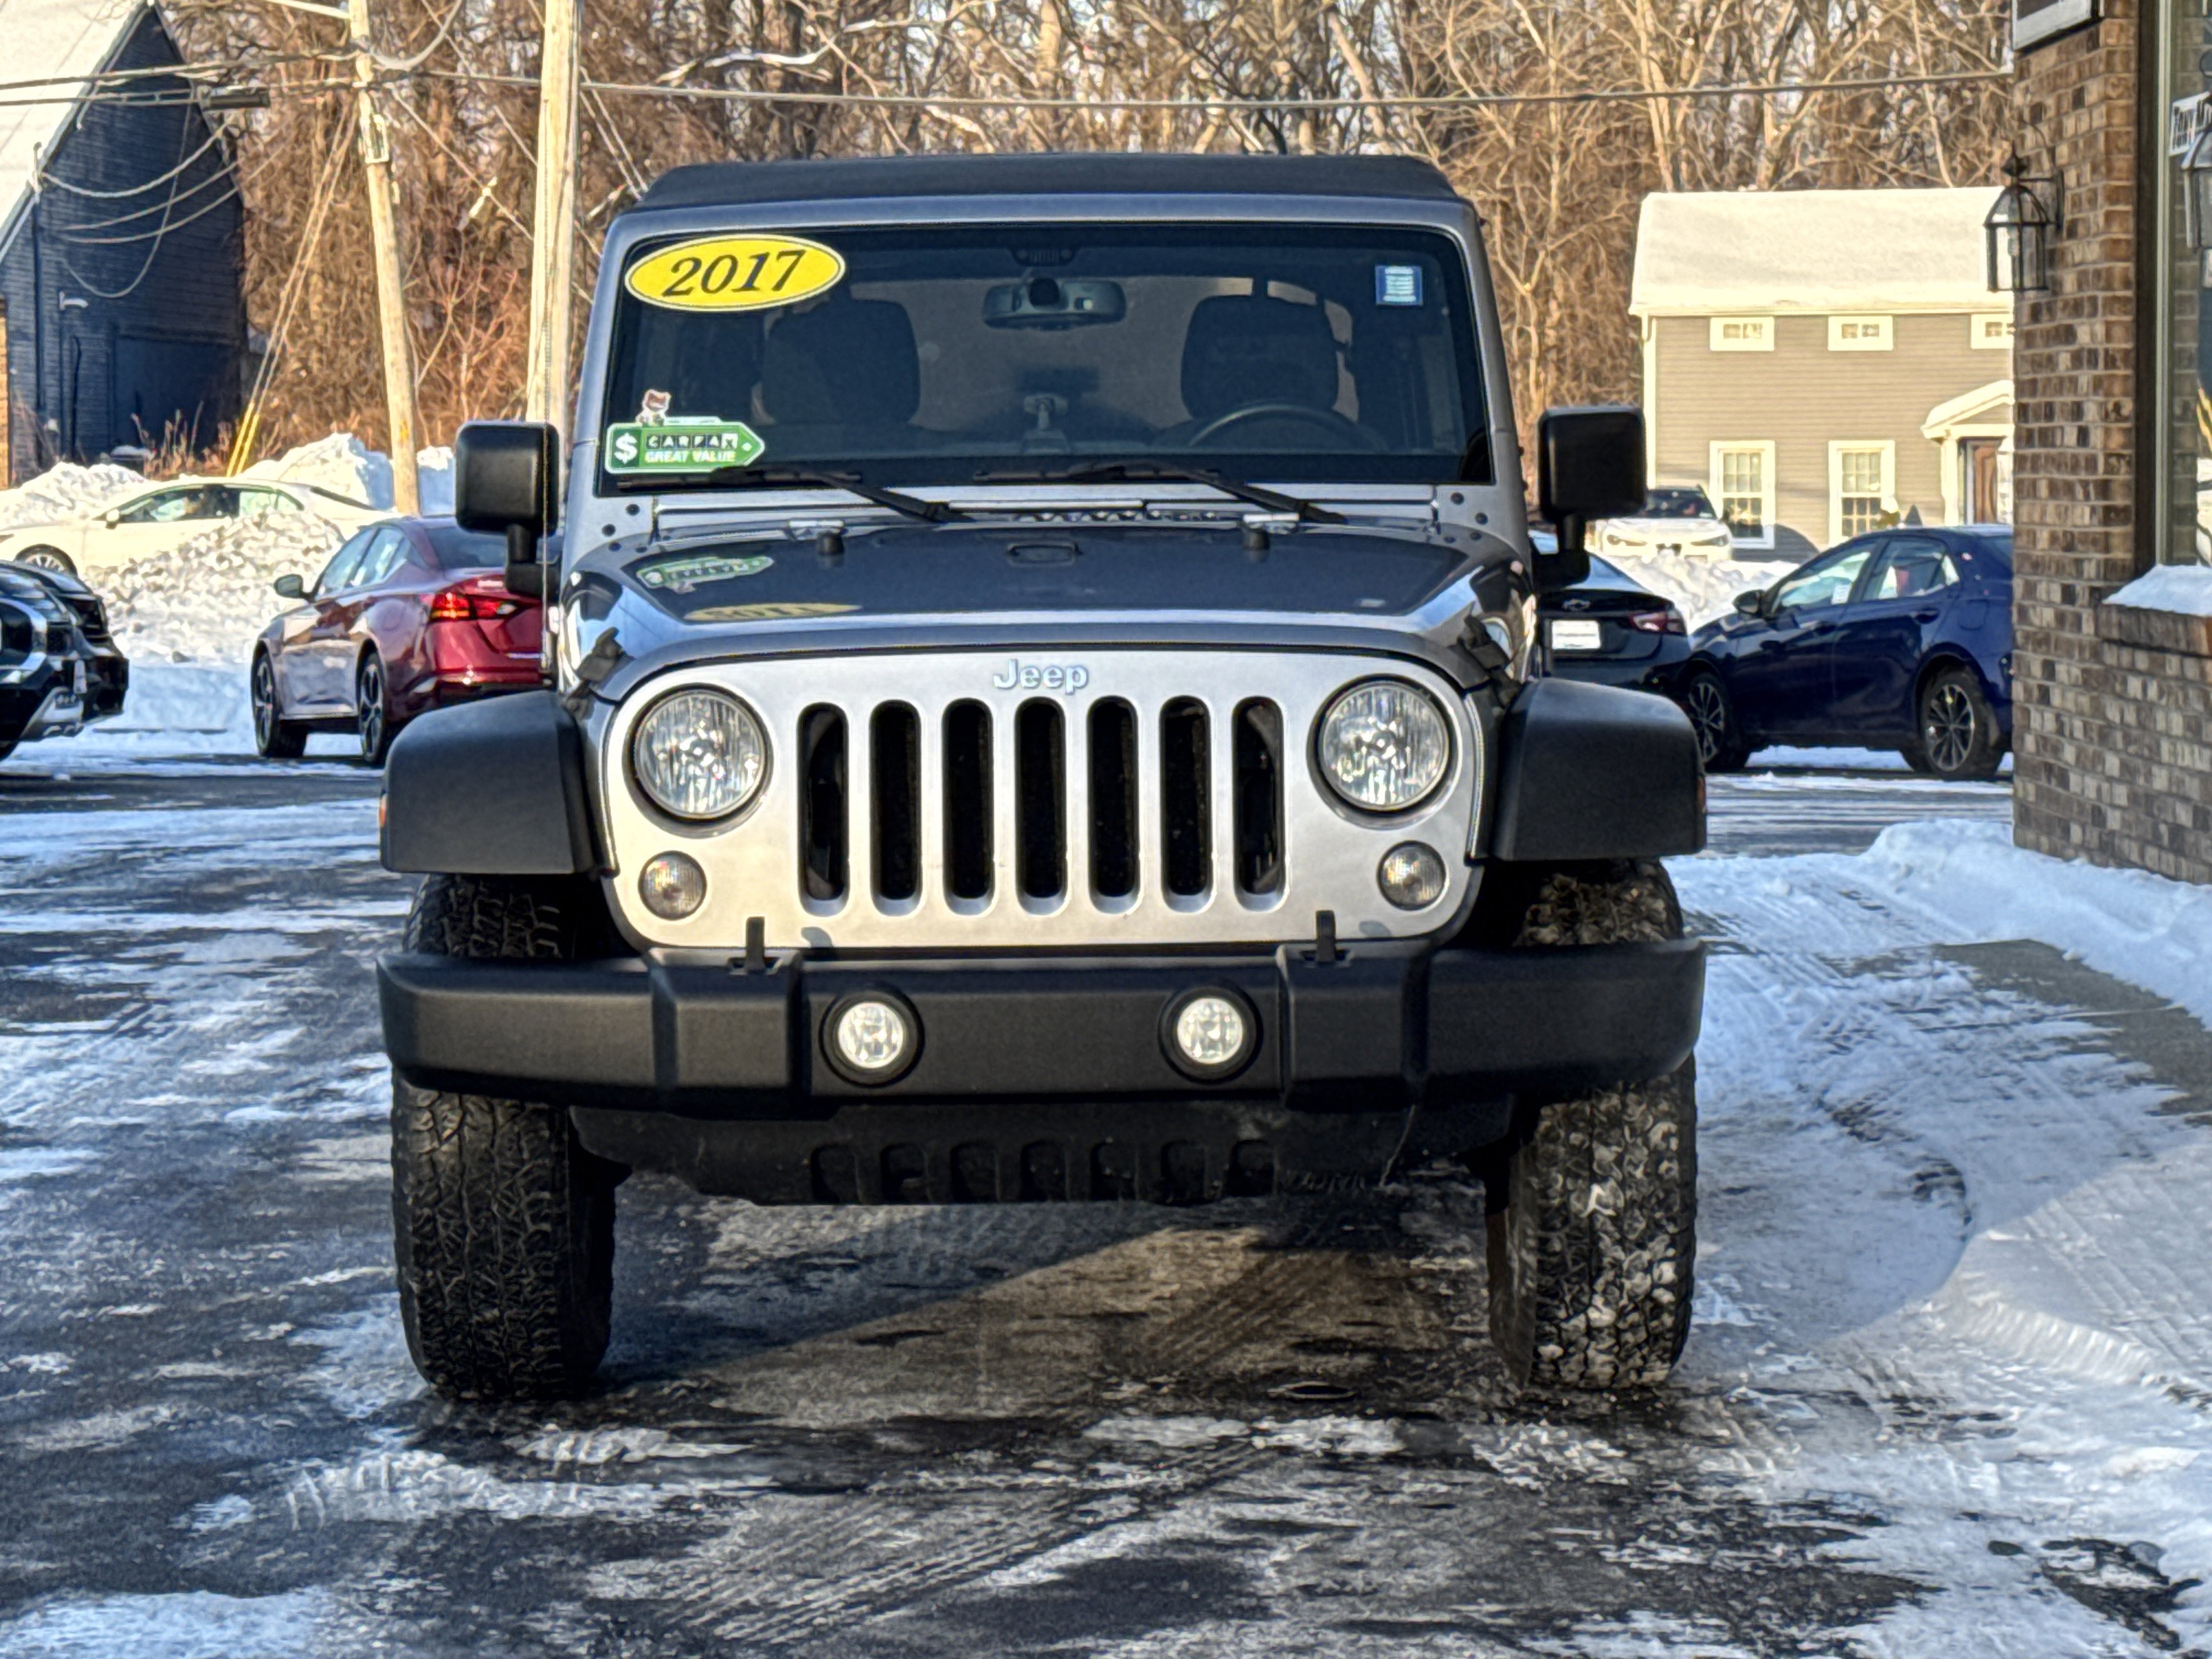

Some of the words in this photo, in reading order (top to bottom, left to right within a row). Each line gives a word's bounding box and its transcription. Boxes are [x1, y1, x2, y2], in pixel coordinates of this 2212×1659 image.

[661, 249, 807, 297] 2017
[645, 450, 689, 463] GREAT
[692, 449, 736, 462] VALUE
[992, 658, 1090, 696] Jeep
